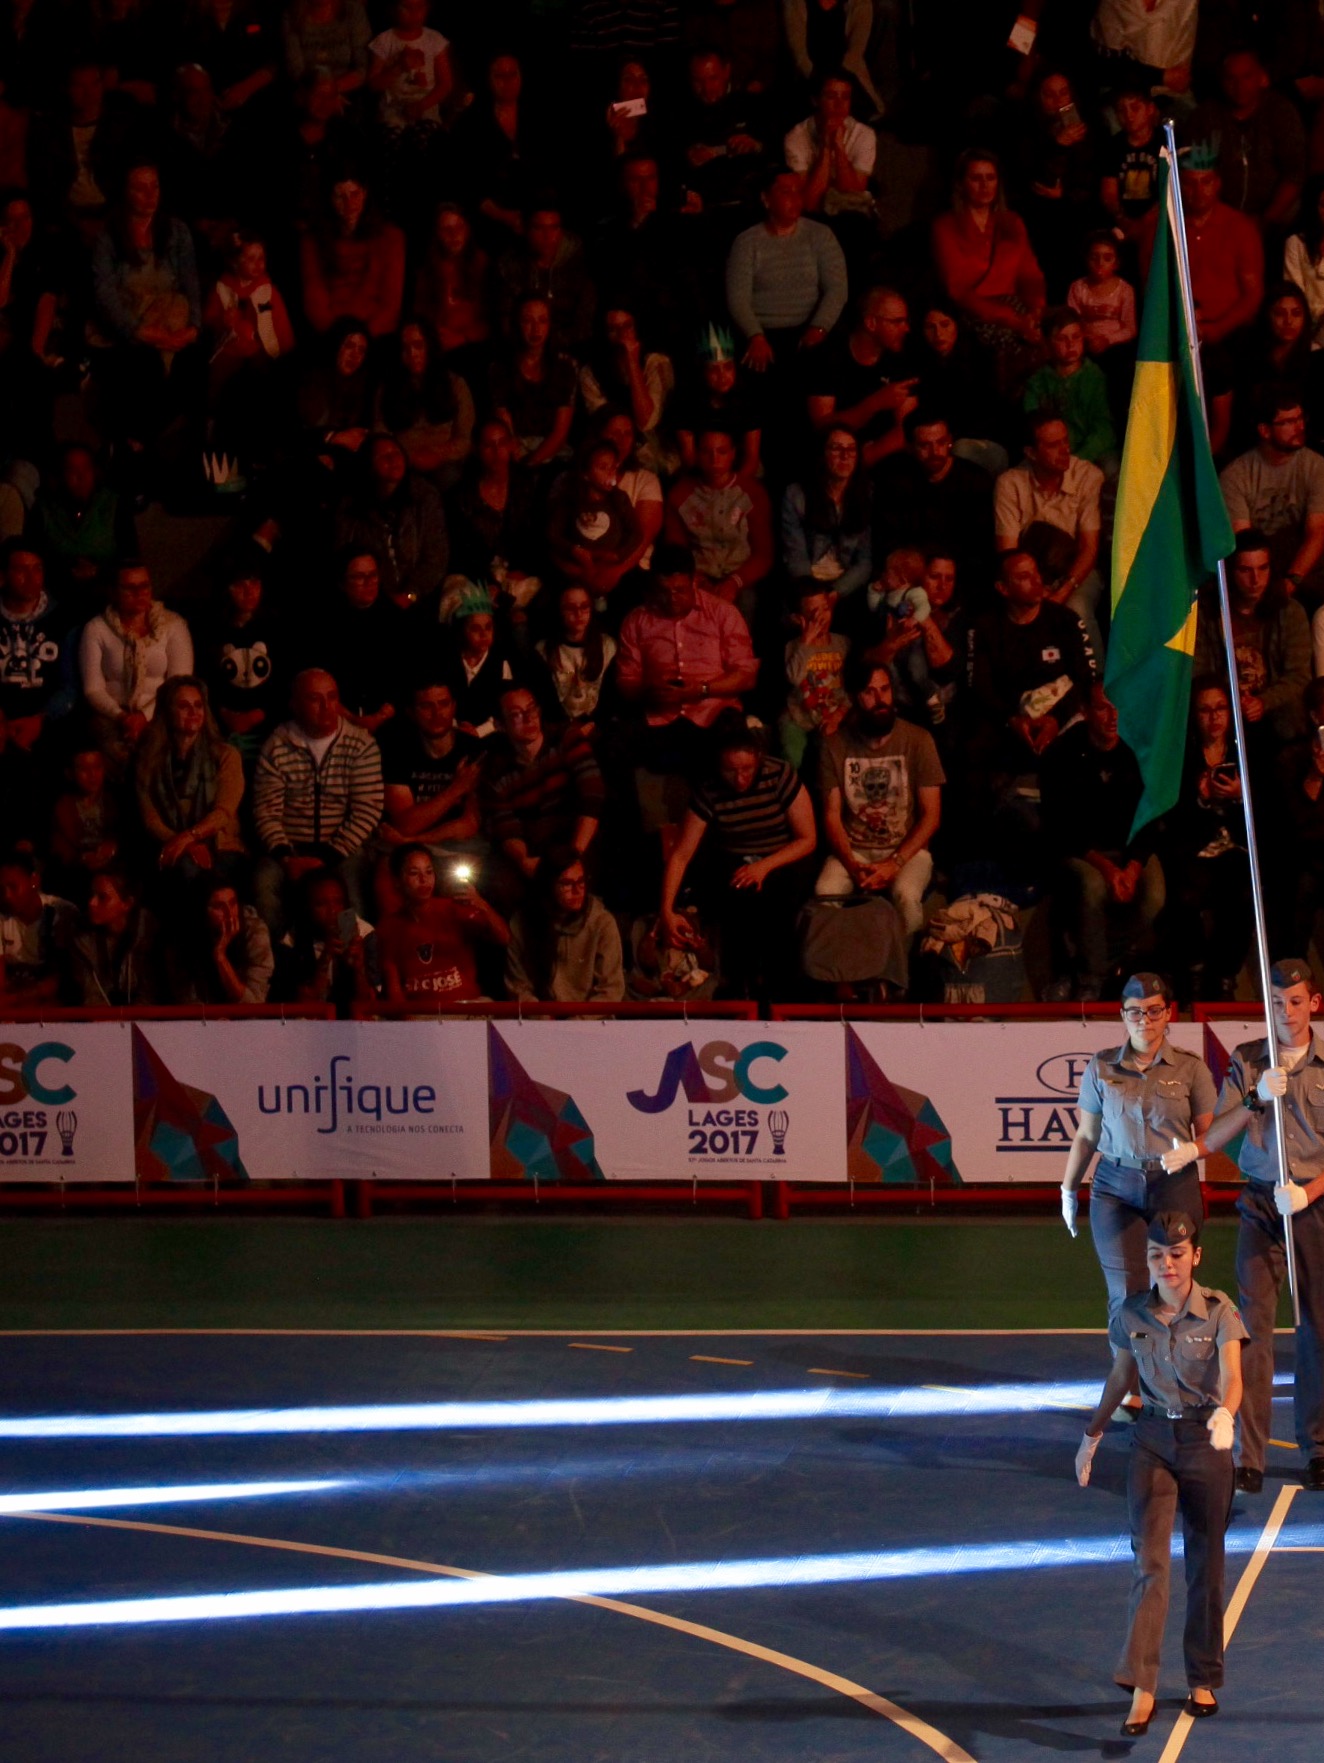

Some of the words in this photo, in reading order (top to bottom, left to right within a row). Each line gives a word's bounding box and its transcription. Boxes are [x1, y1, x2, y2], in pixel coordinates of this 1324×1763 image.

[0, 1041, 77, 1105] SC
[626, 1040, 789, 1113] JASC
[257, 1055, 436, 1134] unifique
[355, 1124, 405, 1134] TECNOLOGIA
[409, 1124, 426, 1133] NOS
[428, 1124, 464, 1133] CONECTA
[688, 1110, 759, 1127] LAGES
[0, 1131, 48, 1156] 017
[688, 1129, 759, 1155] 2017
